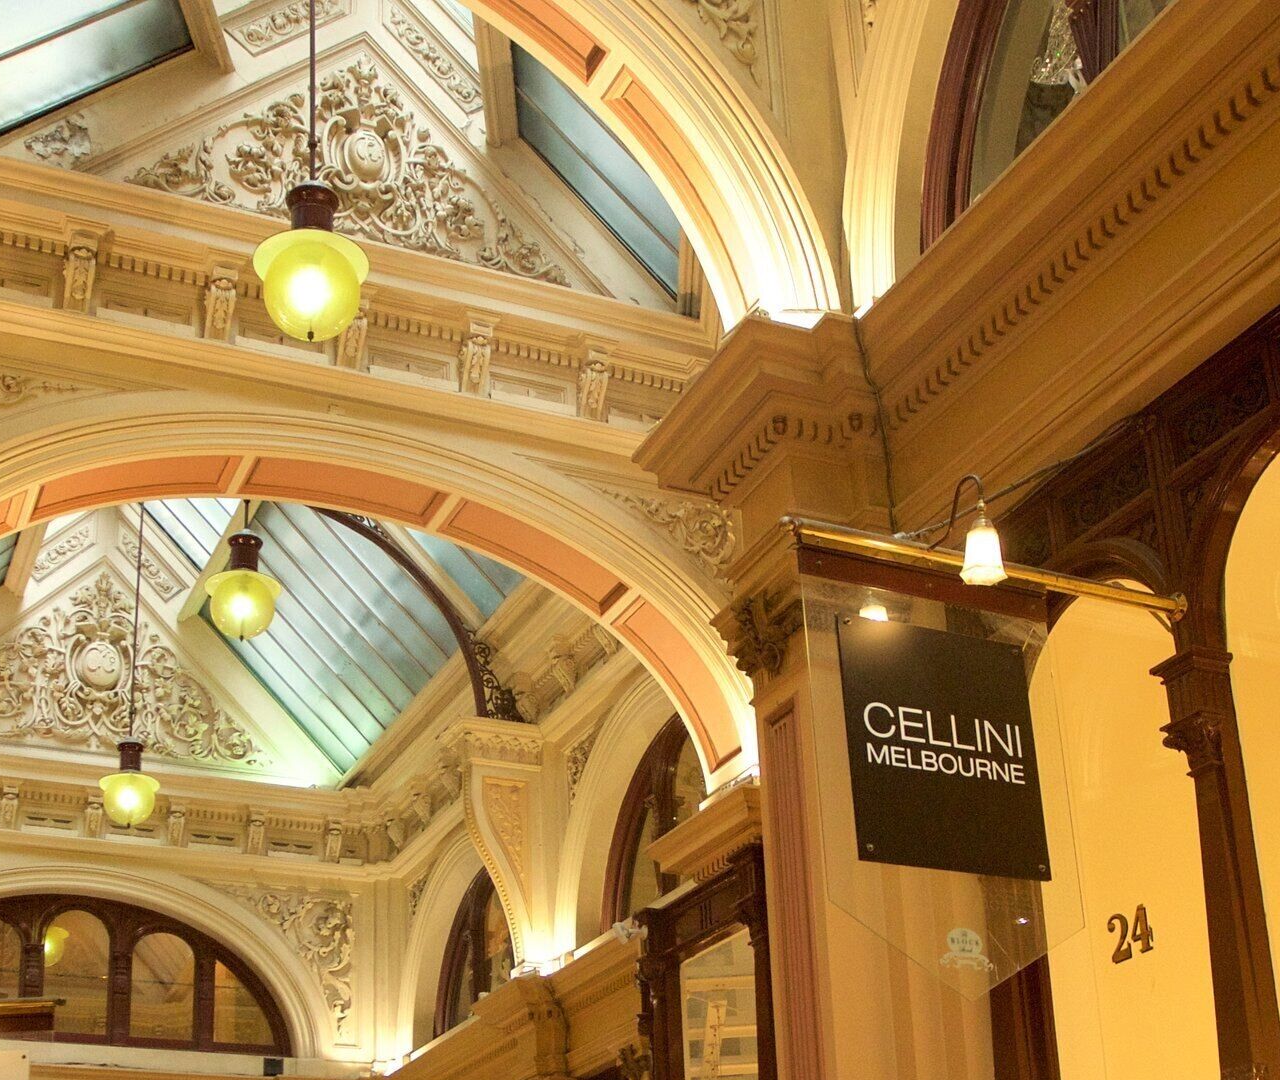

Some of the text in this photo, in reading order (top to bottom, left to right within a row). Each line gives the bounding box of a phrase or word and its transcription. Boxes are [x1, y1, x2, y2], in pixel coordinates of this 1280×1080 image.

[863, 702, 1023, 758] CELLINI
[866, 742, 1026, 785] MELBOURNE
[1107, 904, 1154, 965] 24
